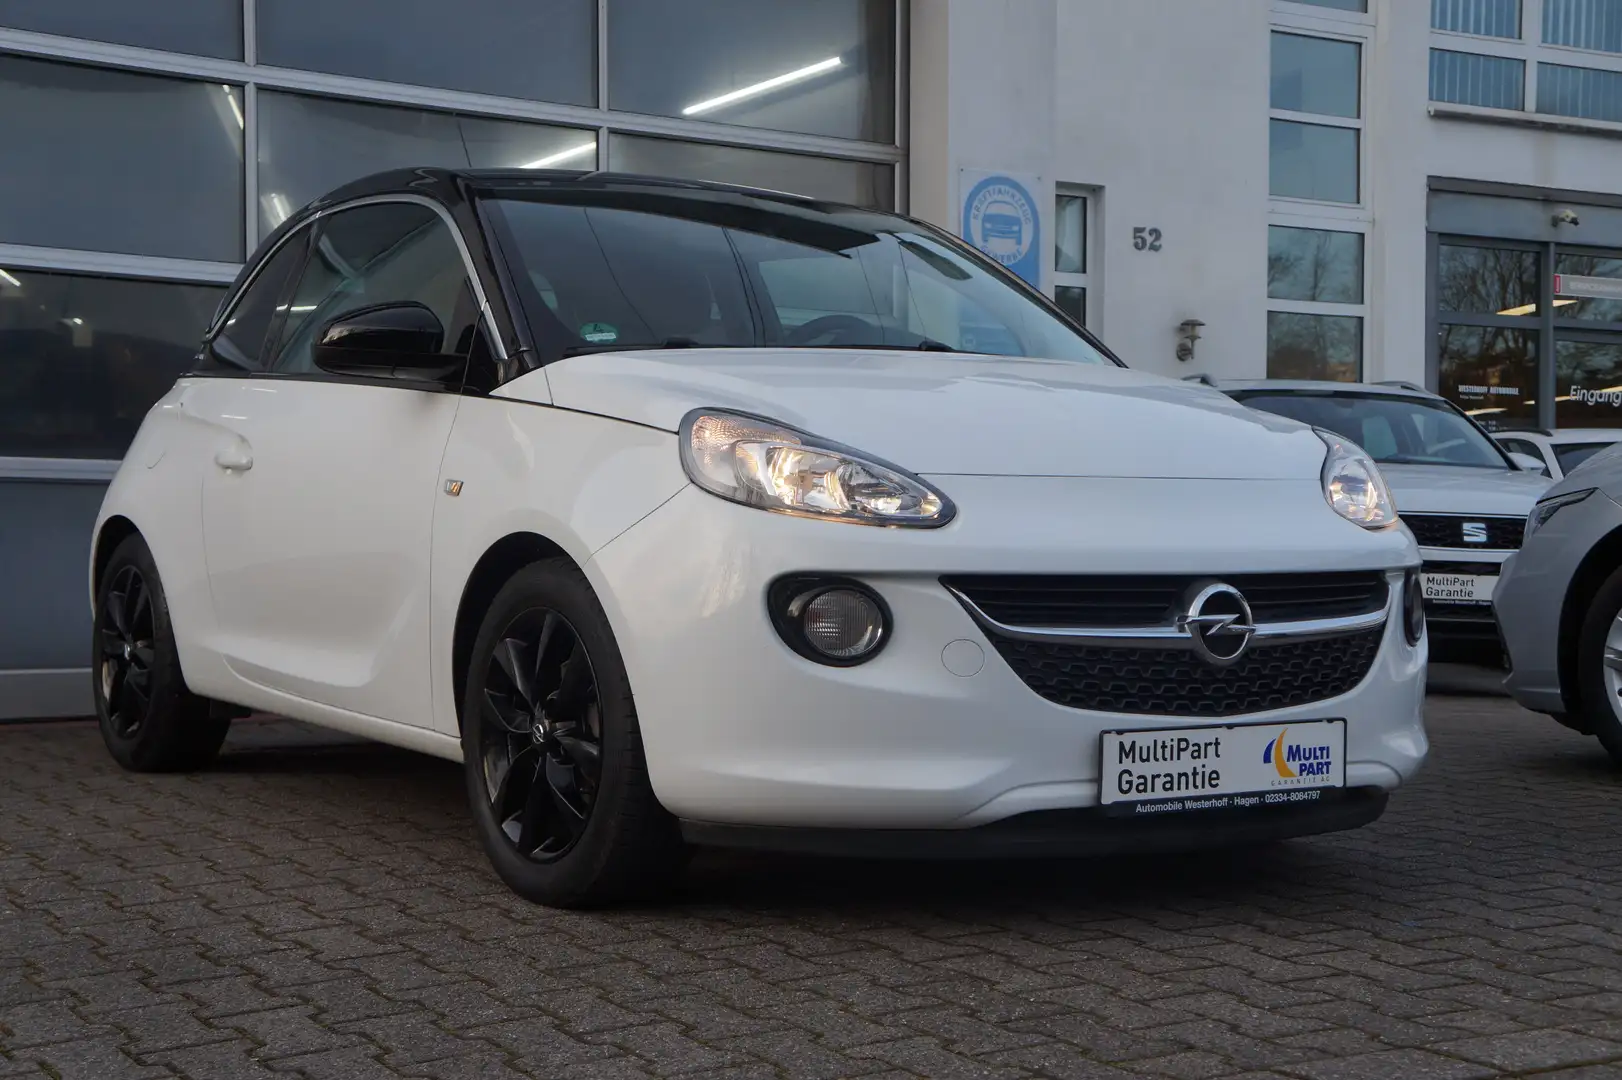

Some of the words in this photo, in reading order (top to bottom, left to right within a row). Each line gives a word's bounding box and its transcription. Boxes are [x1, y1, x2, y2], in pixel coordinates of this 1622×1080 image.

[1133, 226, 1162, 252] 52
[1569, 385, 1622, 407] Eingang
[1425, 586, 1474, 598] Garantie
[1426, 576, 1474, 587] MultiPart
[1118, 737, 1221, 764] MultiPart
[1117, 764, 1220, 794] Garantie
[1299, 761, 1331, 776] PART
[1135, 801, 1182, 813] Automobile
[1184, 797, 1228, 809] Westerhoff
[1234, 796, 1260, 807] Hagen
[1265, 790, 1320, 803] 02334-8084797
